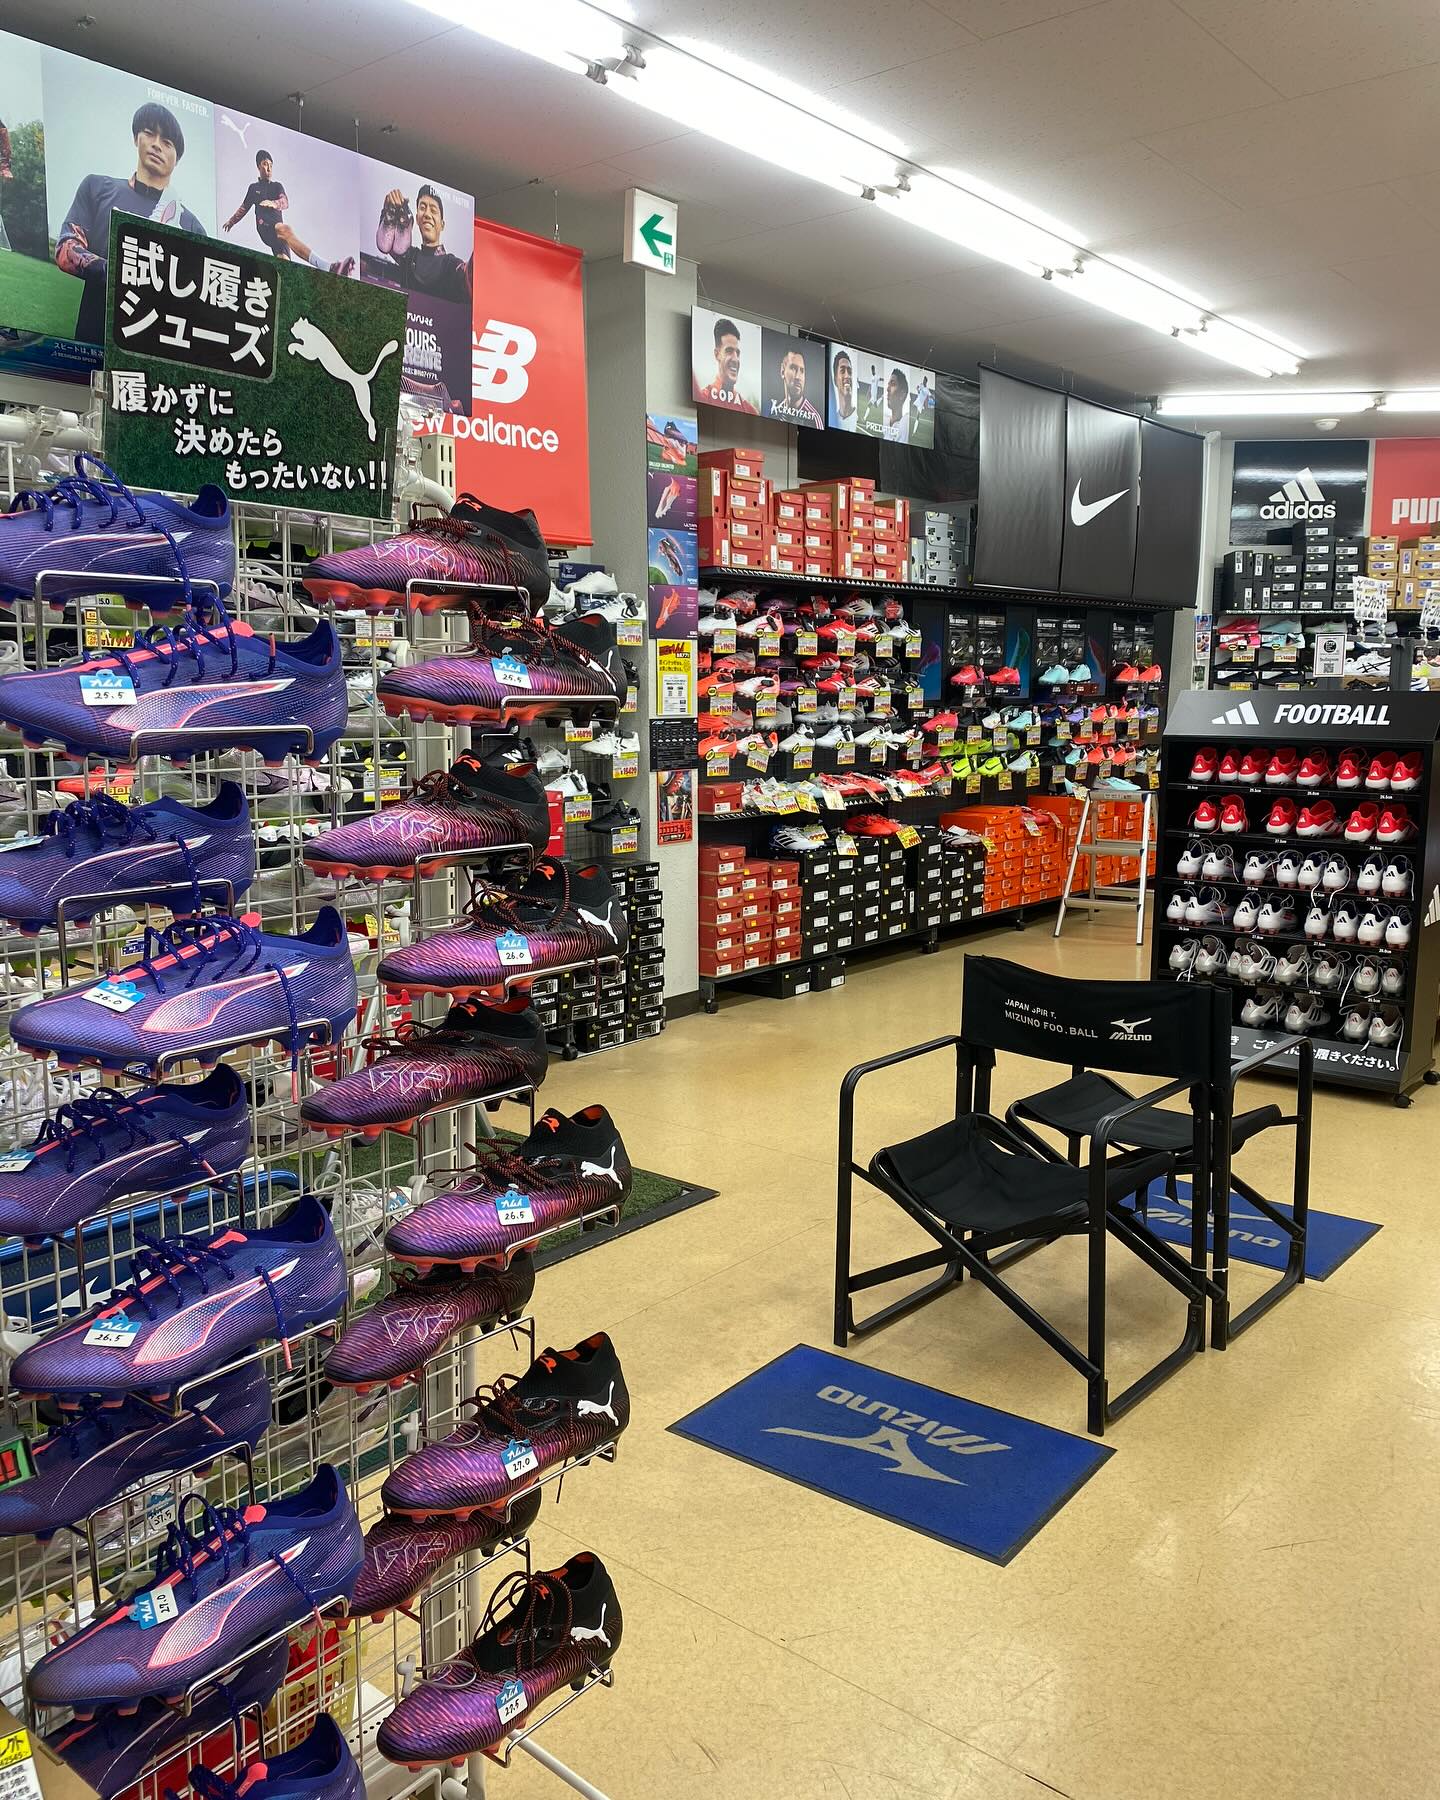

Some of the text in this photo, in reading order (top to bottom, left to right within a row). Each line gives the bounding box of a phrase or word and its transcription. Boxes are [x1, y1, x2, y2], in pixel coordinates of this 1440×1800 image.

[121, 236, 272, 319] 試し履き
[120, 290, 270, 367] シューズ
[405, 327, 437, 352] OURS
[111, 371, 234, 415] 履かずに
[710, 388, 742, 406] COPA
[174, 418, 283, 457] 決めたら
[452, 414, 559, 453] balance
[225, 460, 388, 491] もったいない!!
[1260, 501, 1336, 519] adidas
[503, 674, 522, 683] 25.5
[94, 691, 124, 700] 25.5
[1273, 704, 1390, 725] FOOTBALL
[506, 951, 525, 960] 26.0
[94, 994, 122, 1004] 26.0
[1004, 999, 1029, 1011] JAPAN
[1005, 1010, 1098, 1038] MIZUNO FOOBALL
[1109, 1031, 1152, 1041] MIZUNO
[505, 1211, 525, 1220] 26.5
[95, 1334, 125, 1342] 26.5
[816, 1385, 1012, 1455] MIZUNO
[513, 1457, 530, 1472] 27.0
[157, 1594, 170, 1613] 27.0
